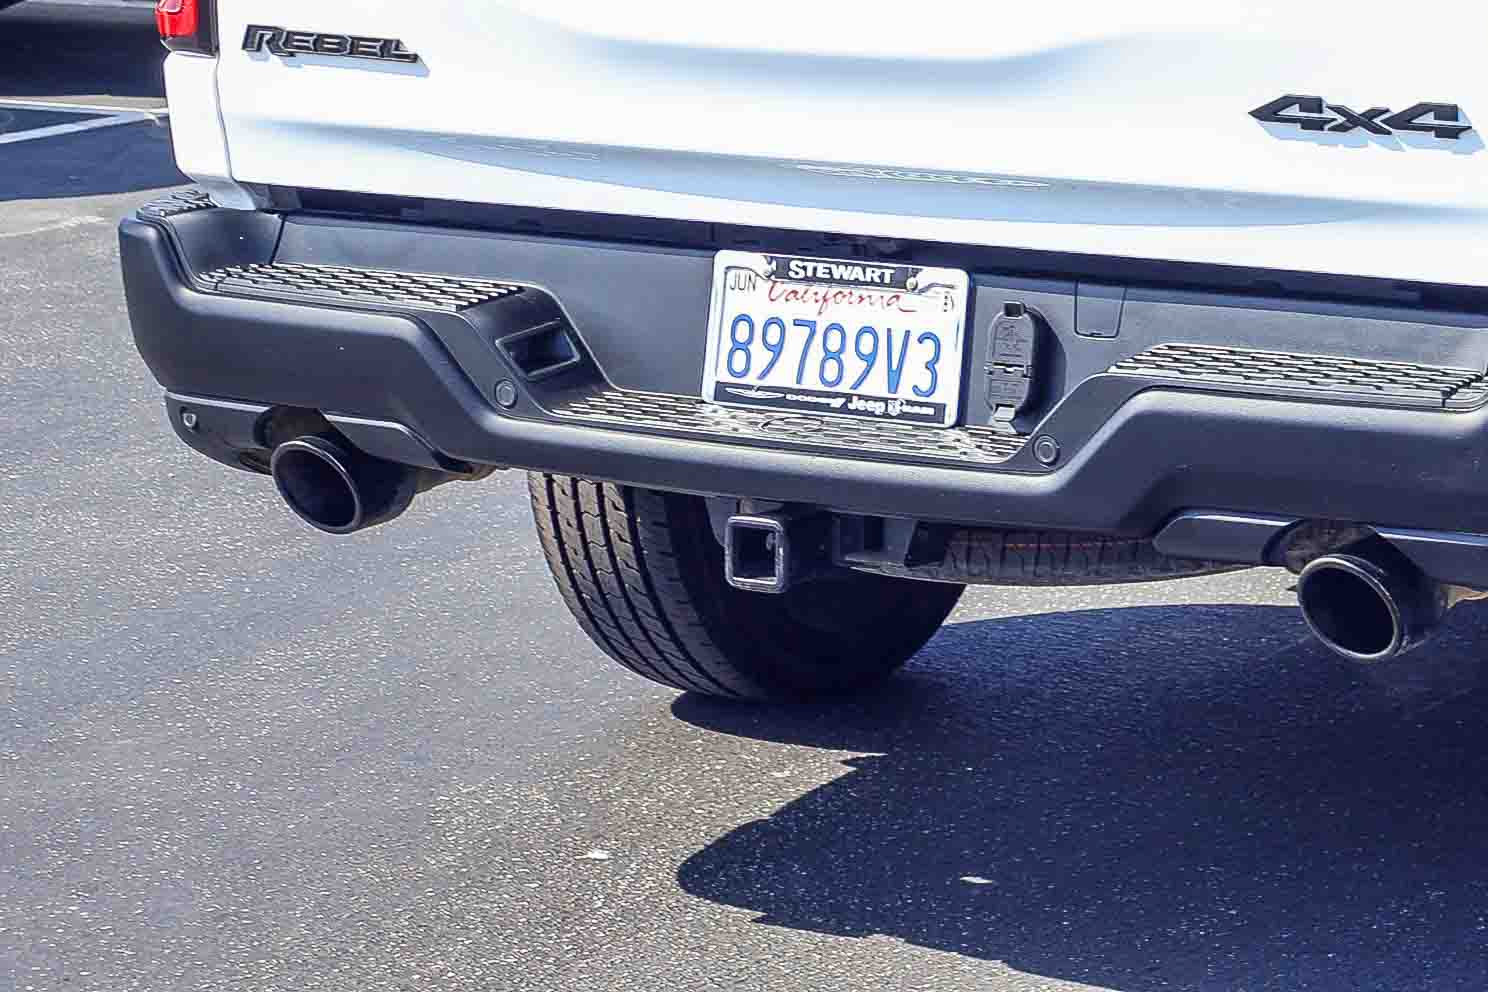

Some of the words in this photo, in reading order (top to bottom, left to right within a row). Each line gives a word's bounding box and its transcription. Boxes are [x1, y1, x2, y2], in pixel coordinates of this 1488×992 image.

[241, 24, 420, 66] REBEL
[729, 271, 757, 293] JUN
[788, 259, 896, 285] STEWART
[767, 279, 917, 316] California
[727, 313, 941, 398] 89789V3
[847, 394, 885, 416] Jeep
